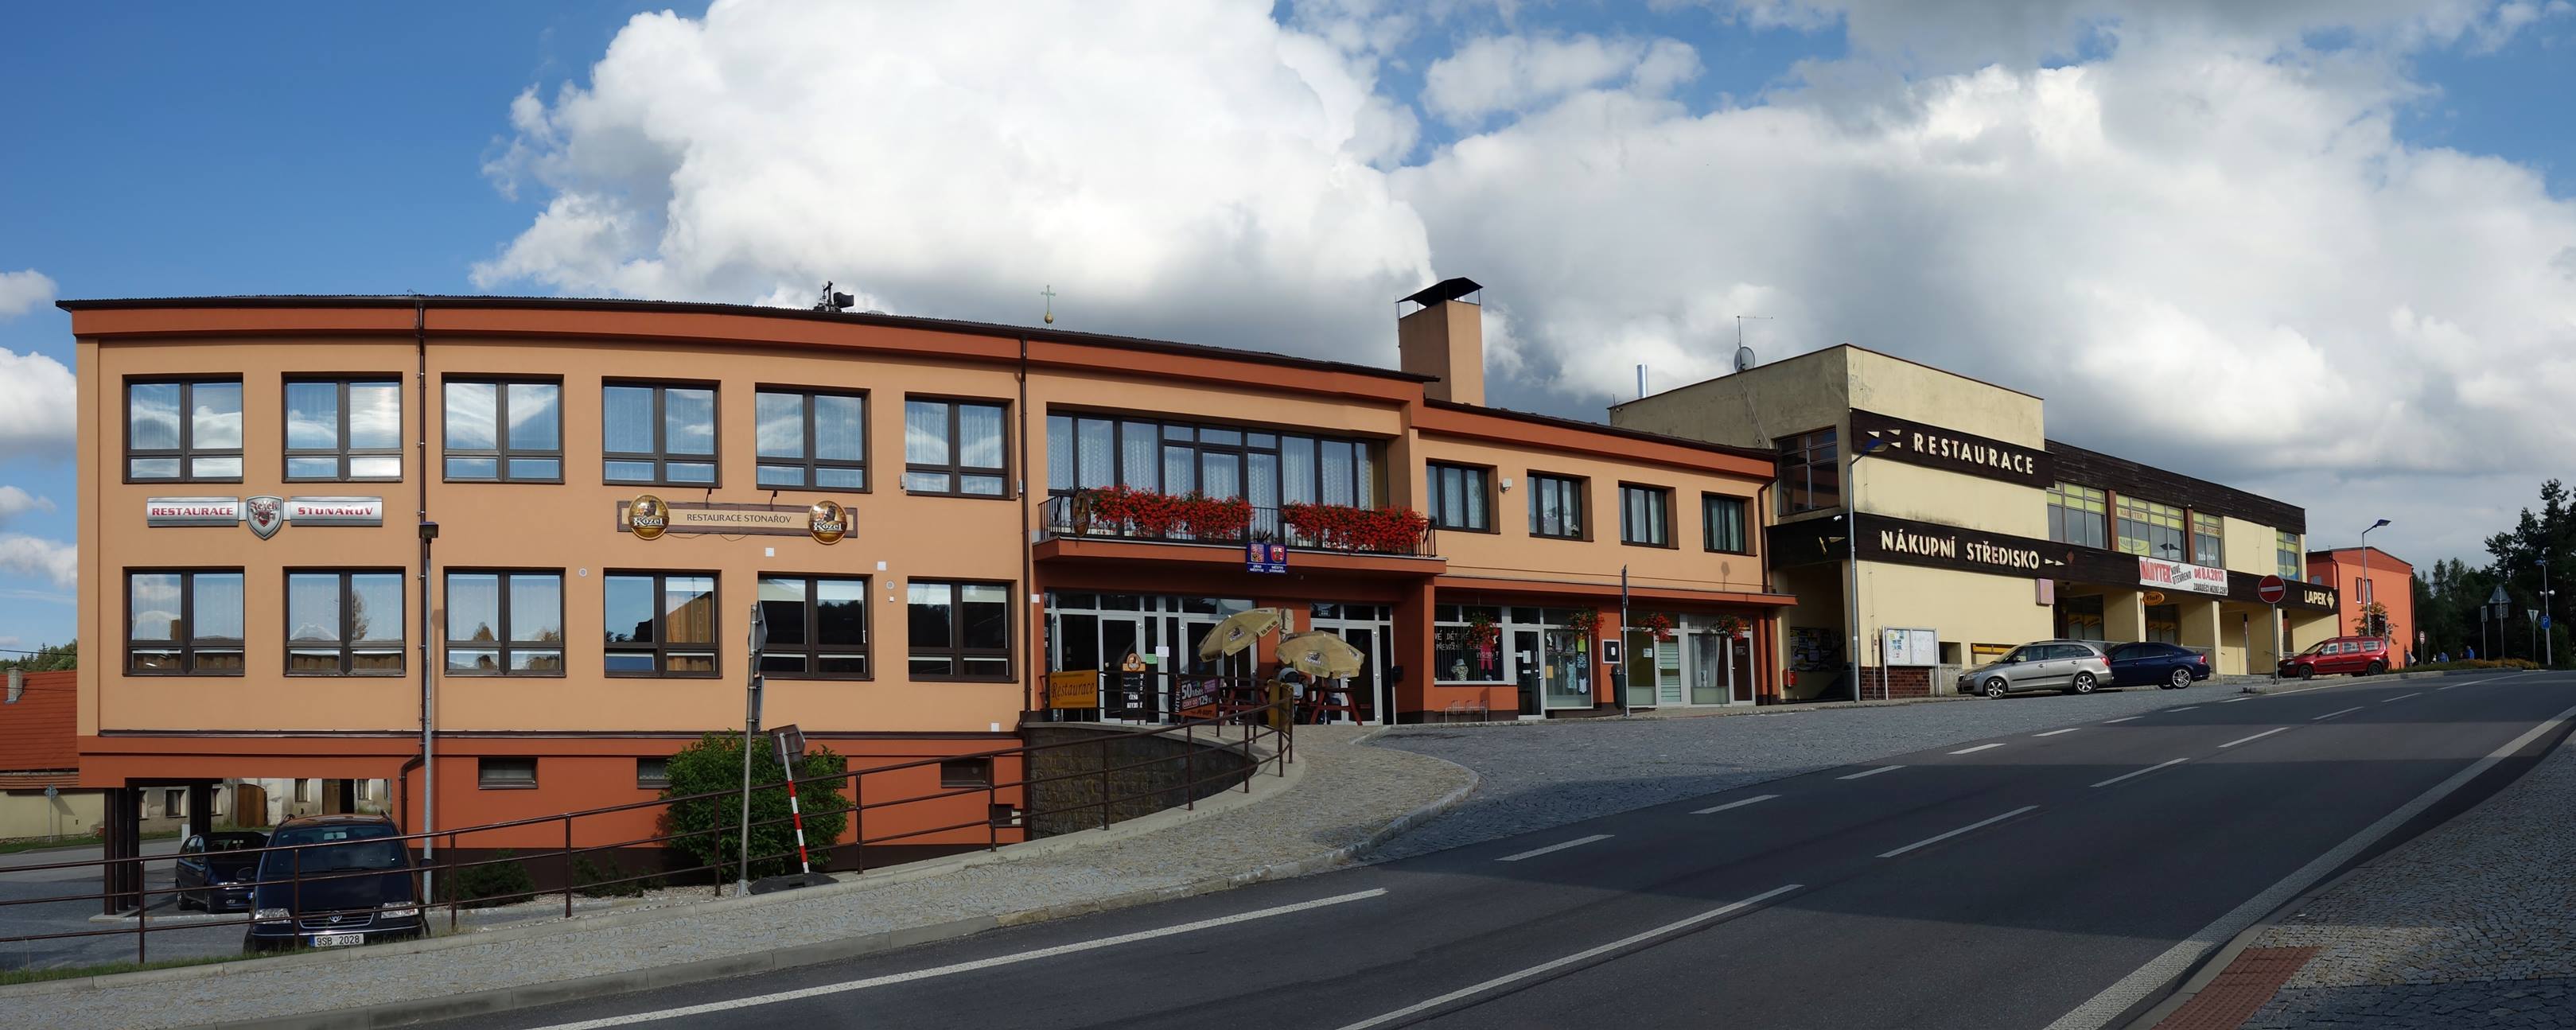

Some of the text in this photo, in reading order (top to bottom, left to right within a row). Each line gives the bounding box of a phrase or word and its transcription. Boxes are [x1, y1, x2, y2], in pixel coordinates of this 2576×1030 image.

[1913, 432, 2033, 475] RESTAURACE
[298, 504, 374, 515] STONAŘOV
[633, 517, 664, 527] Kozel
[687, 513, 792, 523] RESTAURACE STONAŘOV
[813, 522, 842, 531] Kozel
[1881, 528, 2040, 570] NÁKUPNÍ STŘEDISKO
[2140, 558, 2172, 583] NÁBYTEK
[2194, 567, 2201, 579] od
[2304, 590, 2326, 605] LAPEK
[1052, 682, 1095, 700] Restaurace
[1181, 683, 1192, 700] 50
[1199, 694, 1208, 705] 129
[317, 935, 360, 946] 9SB 2028
